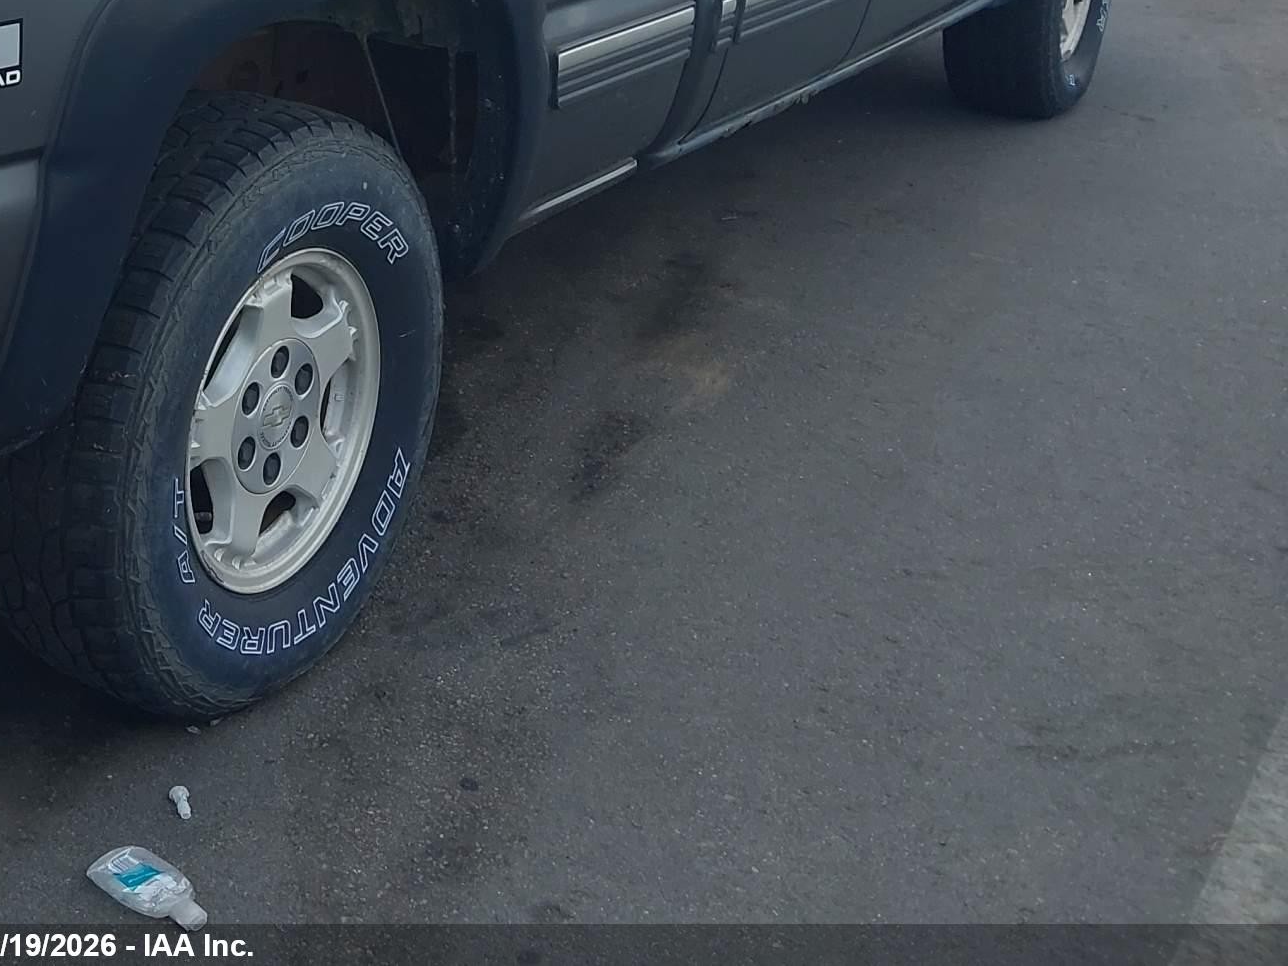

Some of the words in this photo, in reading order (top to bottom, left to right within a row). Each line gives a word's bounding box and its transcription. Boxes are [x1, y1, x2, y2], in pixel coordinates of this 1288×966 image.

[257, 201, 410, 274] COOPER
[172, 477, 196, 583] A/T
[198, 447, 411, 656] ADVENTURER
